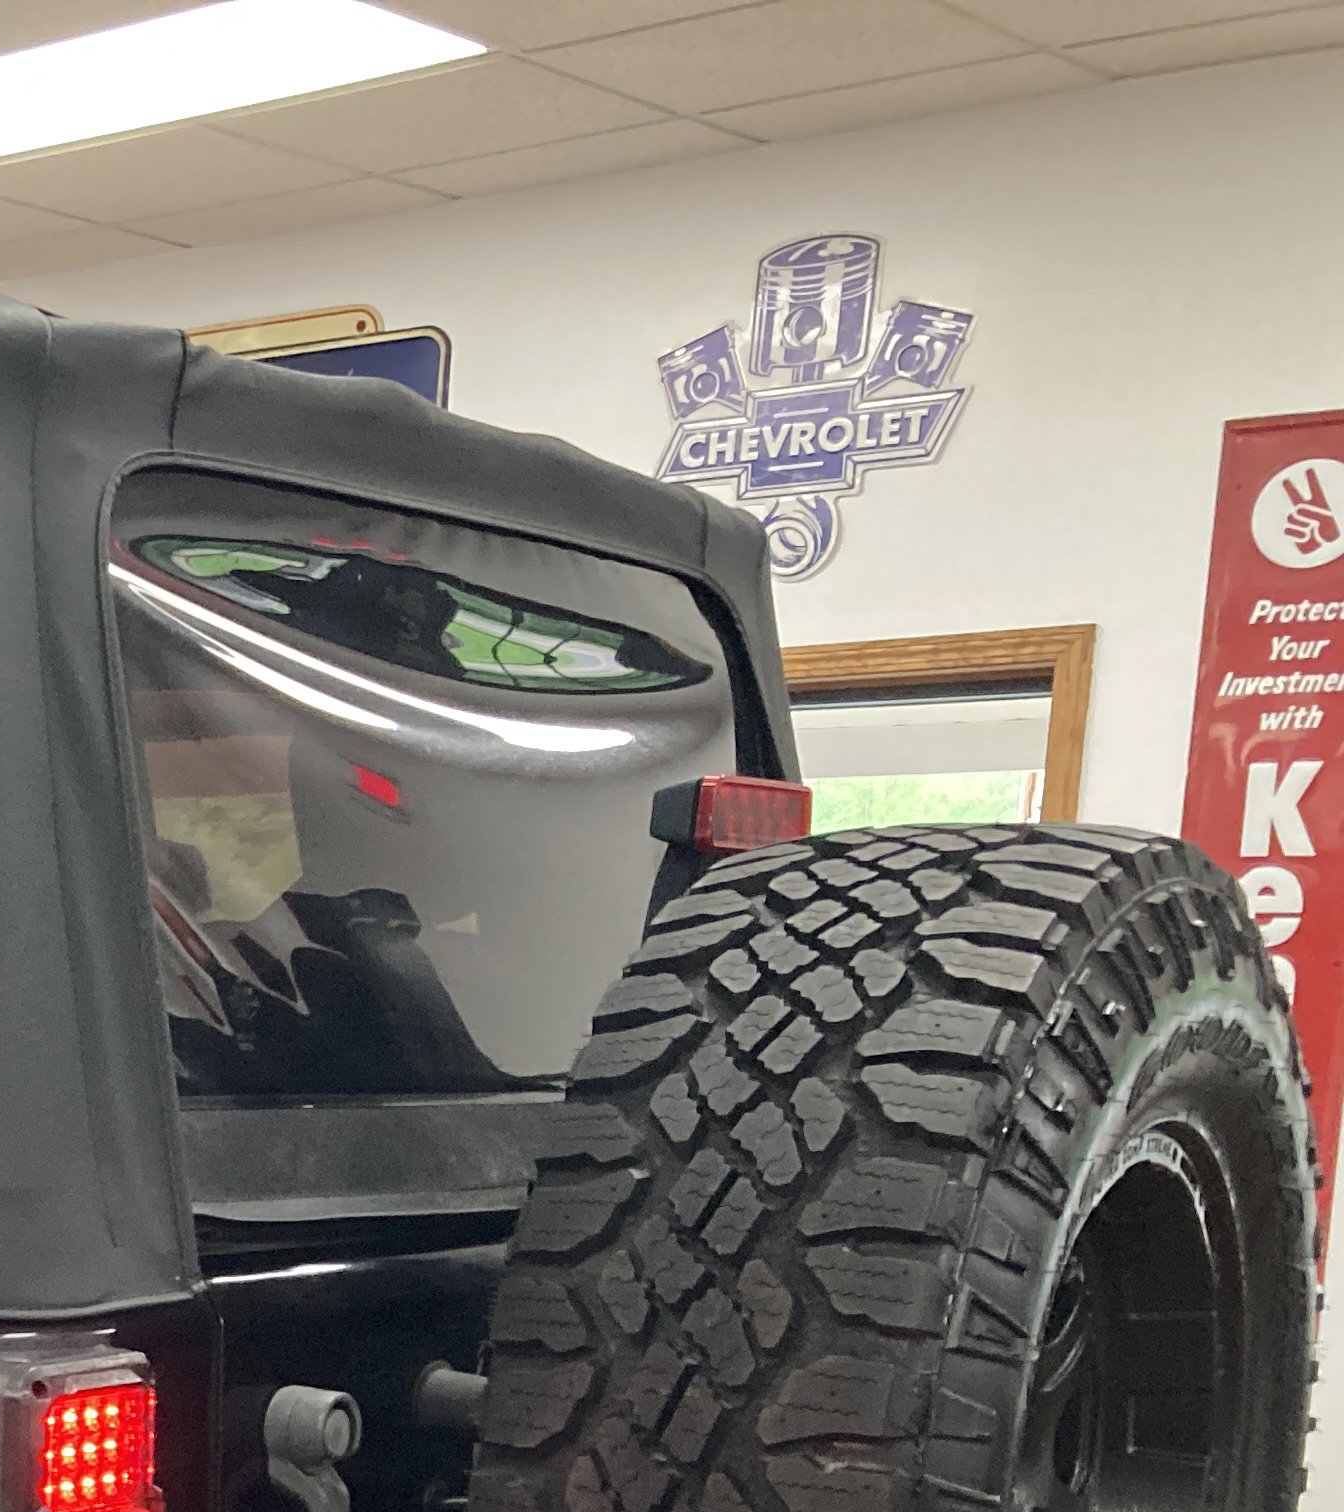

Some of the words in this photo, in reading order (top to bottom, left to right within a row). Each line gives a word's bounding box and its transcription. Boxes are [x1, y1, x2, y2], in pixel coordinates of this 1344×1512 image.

[679, 407, 930, 469] CHEVROLET
[1269, 635, 1330, 661] Your
[1260, 704, 1324, 731] with
